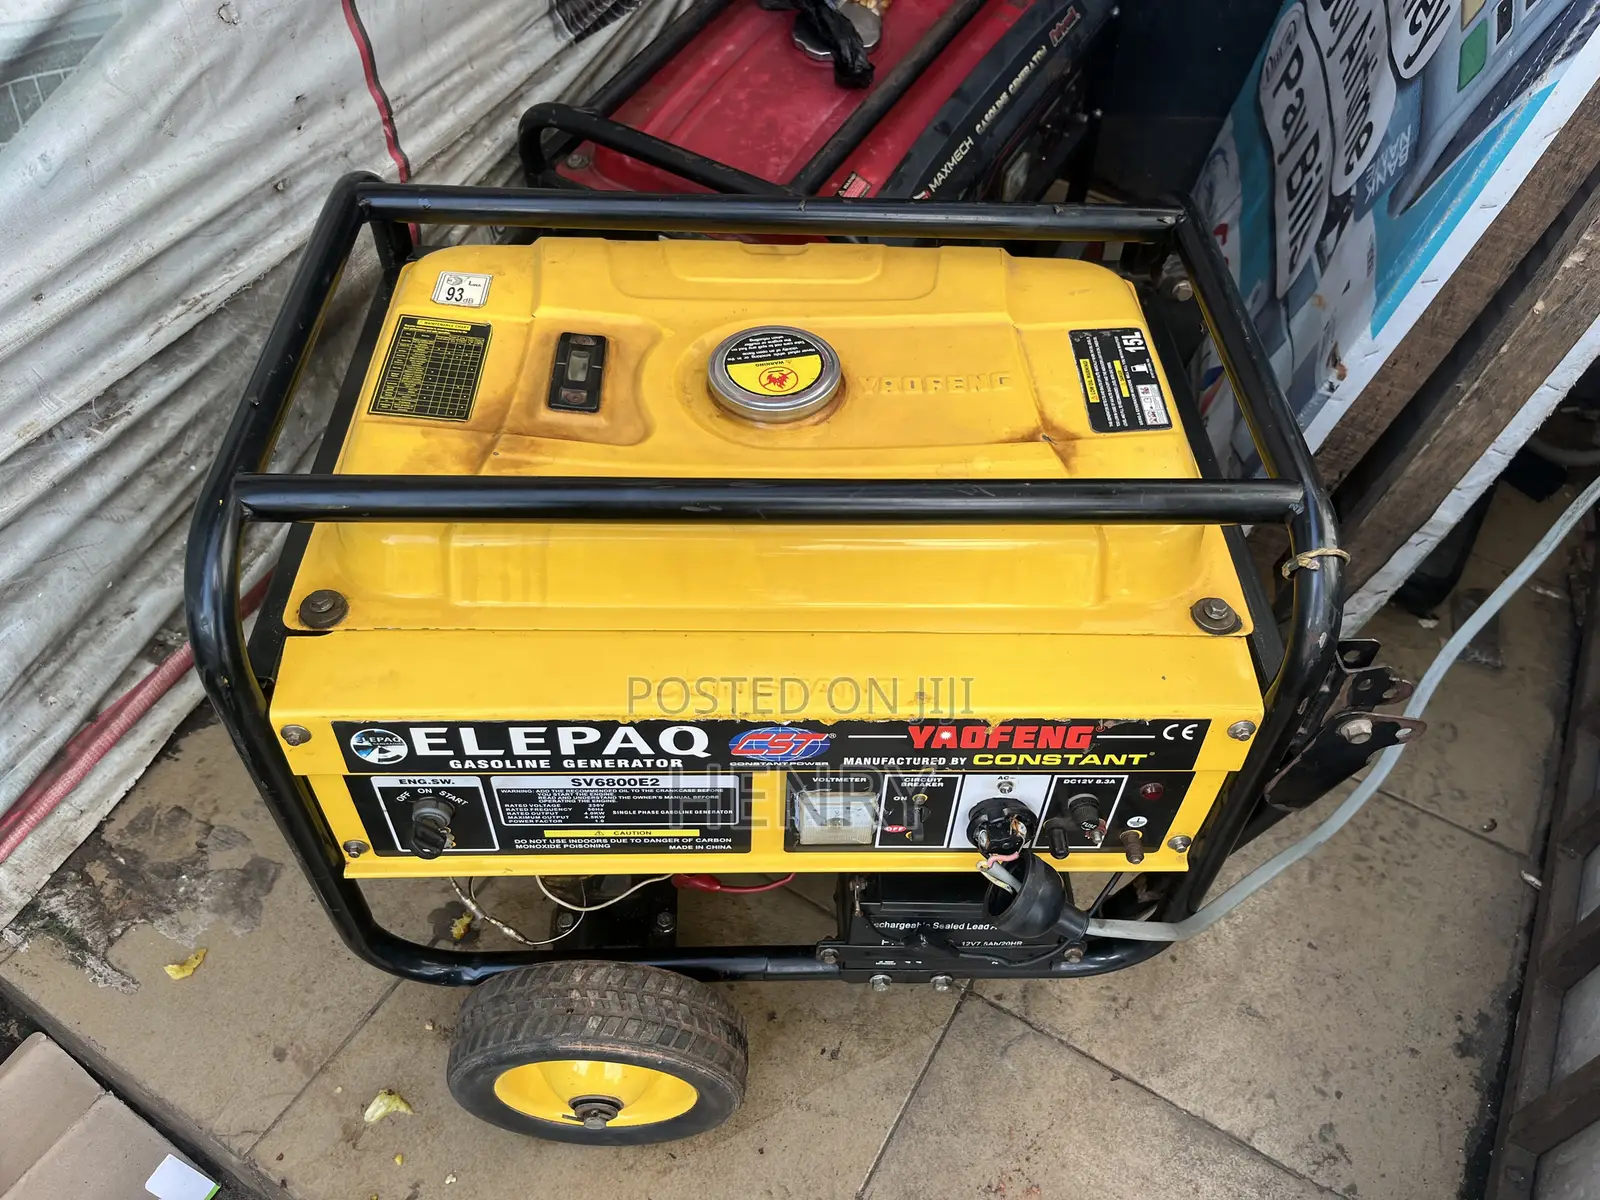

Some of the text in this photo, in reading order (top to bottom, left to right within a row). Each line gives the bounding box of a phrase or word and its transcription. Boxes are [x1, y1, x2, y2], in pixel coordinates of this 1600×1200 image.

[1339, 10, 1377, 176] Airtime
[1272, 43, 1308, 165] Pay
[928, 136, 974, 192] MAXMECH
[1286, 128, 1323, 274] Bills
[446, 286, 464, 302] 93
[1121, 332, 1146, 352] 15L
[908, 726, 1094, 748] YAOFENG
[1162, 724, 1198, 740] CE
[409, 726, 712, 758] ELEPAQ
[730, 733, 829, 756] CST
[449, 758, 683, 769] GASOLINE GENERATOR
[843, 753, 1148, 766] MANUFACTURED BY CONSTANT
[570, 778, 660, 787] SV6800E2
[396, 791, 412, 802] OFF
[438, 790, 469, 806] START
[1082, 821, 1097, 829] FUSE
[932, 922, 965, 930] Sealed
[966, 922, 990, 930] Lead
